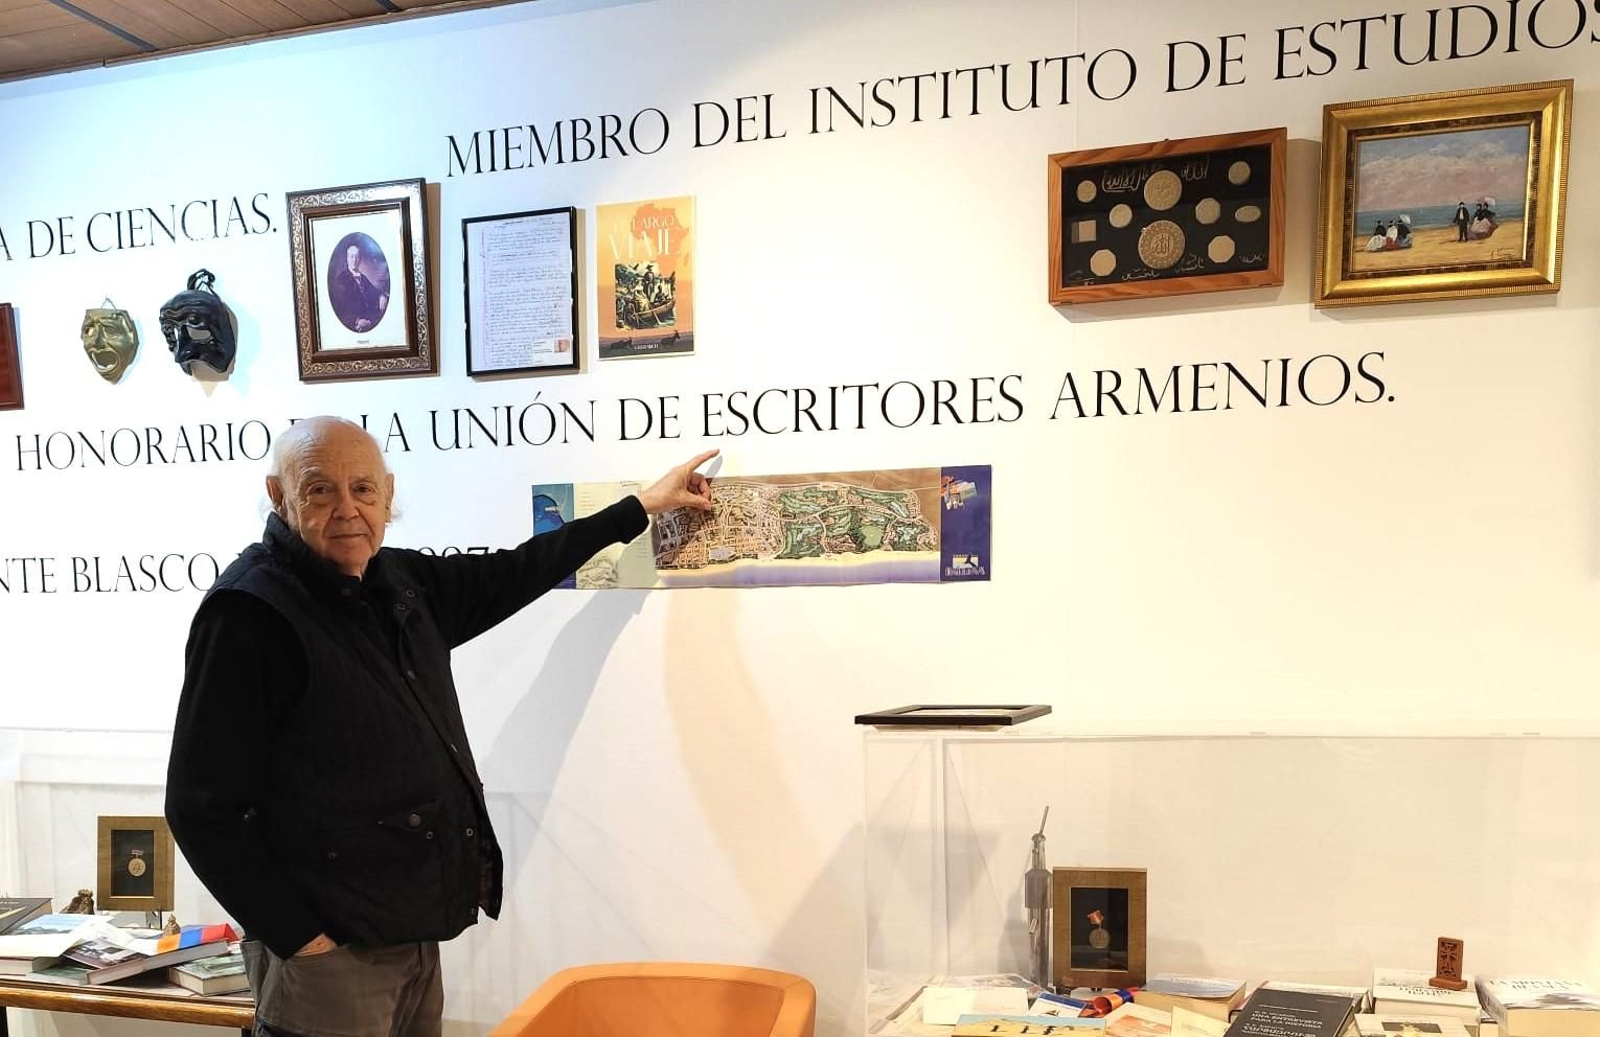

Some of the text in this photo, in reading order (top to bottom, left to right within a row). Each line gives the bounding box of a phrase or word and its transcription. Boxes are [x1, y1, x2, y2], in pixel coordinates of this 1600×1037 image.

[444, 108, 670, 178] MIEMBRO
[693, 93, 787, 149] DEL
[809, 48, 1137, 135] INSTITUTO
[1165, 34, 1247, 94] DE
[26, 216, 76, 259] DE
[86, 192, 278, 253] CIENCIAS.
[608, 227, 681, 261] VIAJE
[16, 419, 271, 472] HONORARIO
[429, 391, 596, 452] UNIÓN
[618, 396, 681, 441] DE
[701, 376, 1023, 437] ESCRITORES
[1049, 351, 1395, 421] ARMENIOS.
[71, 552, 220, 593] BLASCO
